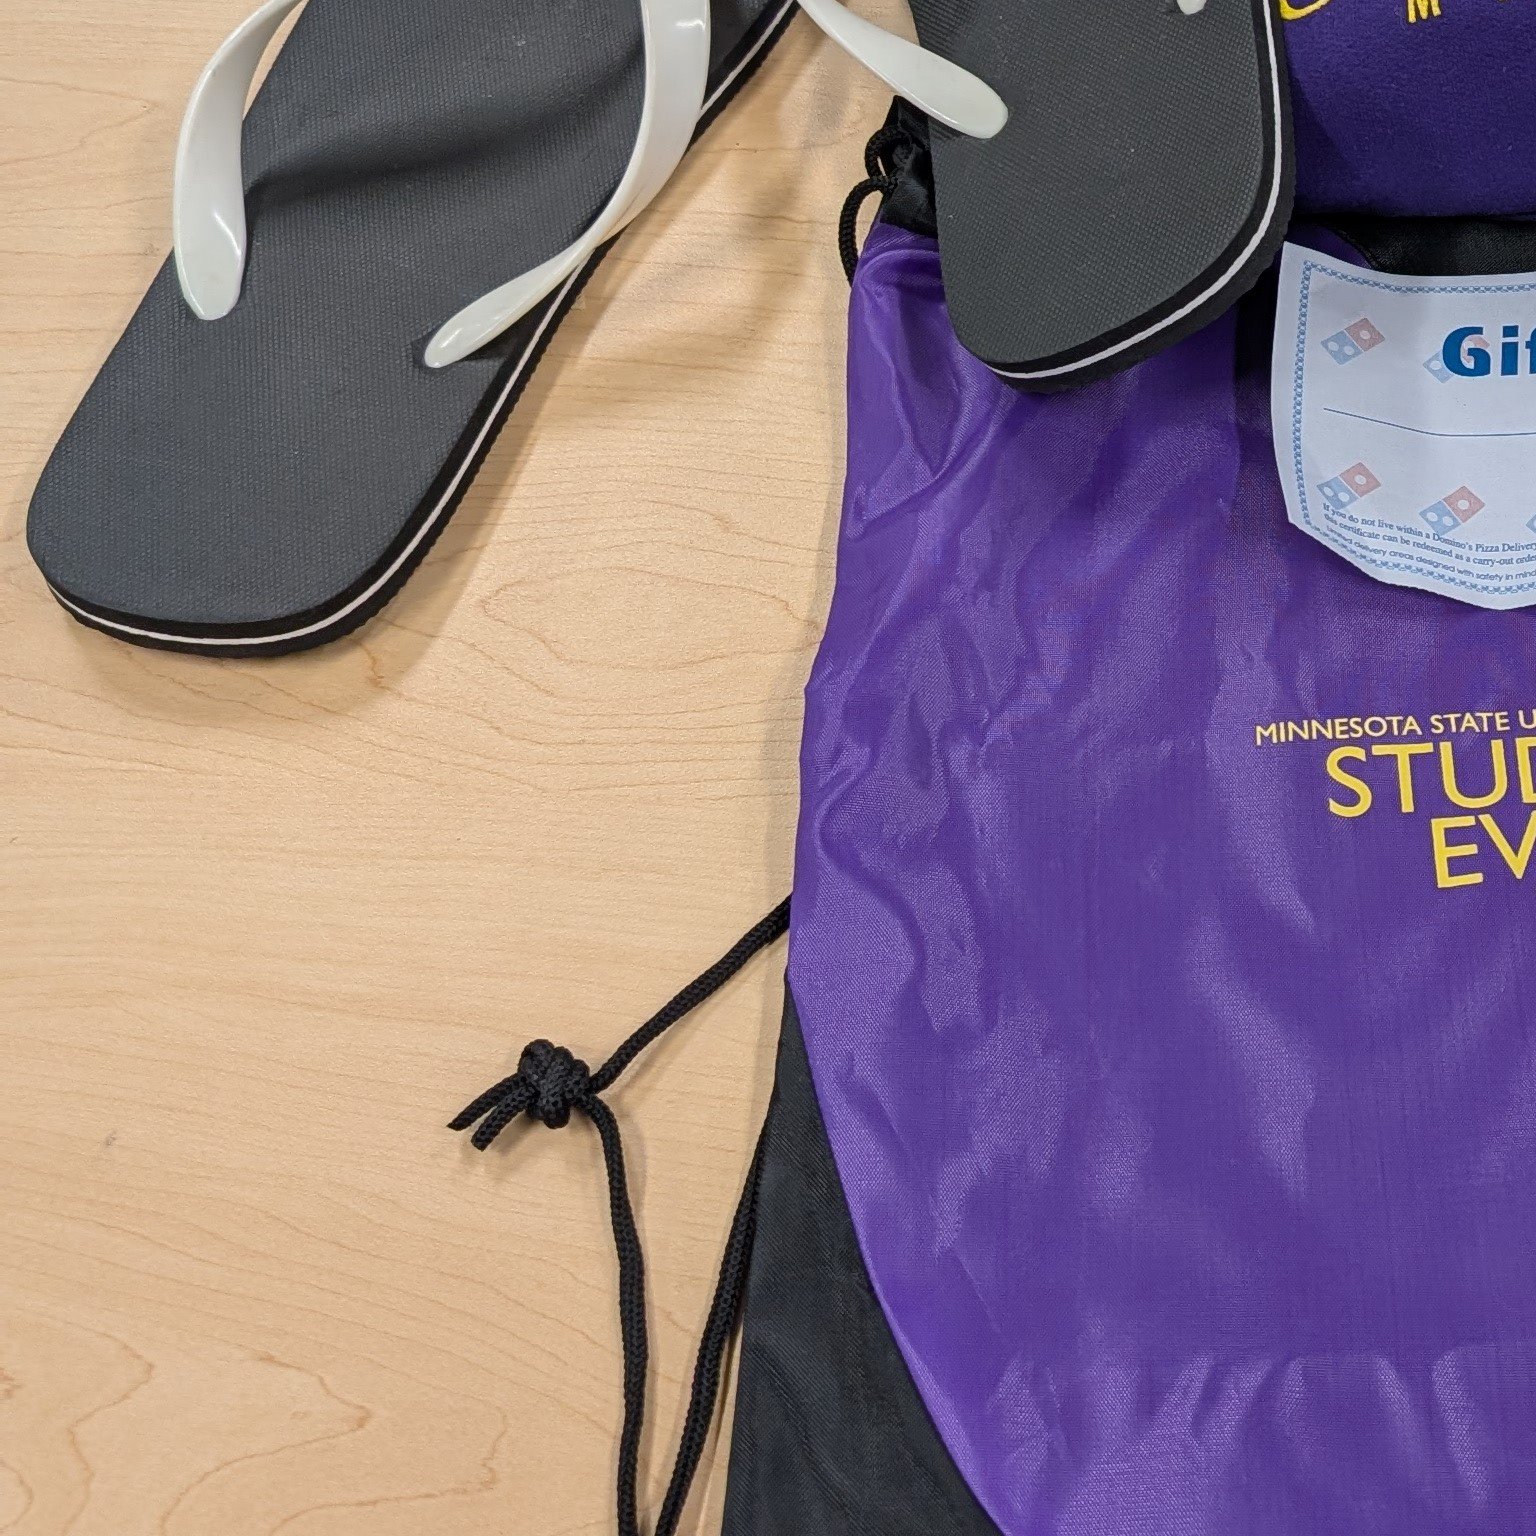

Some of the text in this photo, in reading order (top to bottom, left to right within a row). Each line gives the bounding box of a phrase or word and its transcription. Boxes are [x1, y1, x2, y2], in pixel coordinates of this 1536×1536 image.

[1339, 523, 1381, 540] certificate
[1382, 535, 1399, 543] can
[1400, 536, 1411, 545] be
[1413, 542, 1453, 557] redeemed
[1472, 556, 1514, 567] carry-out
[1348, 514, 1359, 524] do
[1361, 518, 1376, 527] not
[1396, 525, 1424, 538] within
[1475, 544, 1500, 552] Pizza
[1416, 556, 1456, 572] designed
[1457, 567, 1474, 577] with
[1476, 573, 1503, 582] safety
[1255, 715, 1424, 746] MINNESOTA
[1430, 711, 1511, 735] STATE
